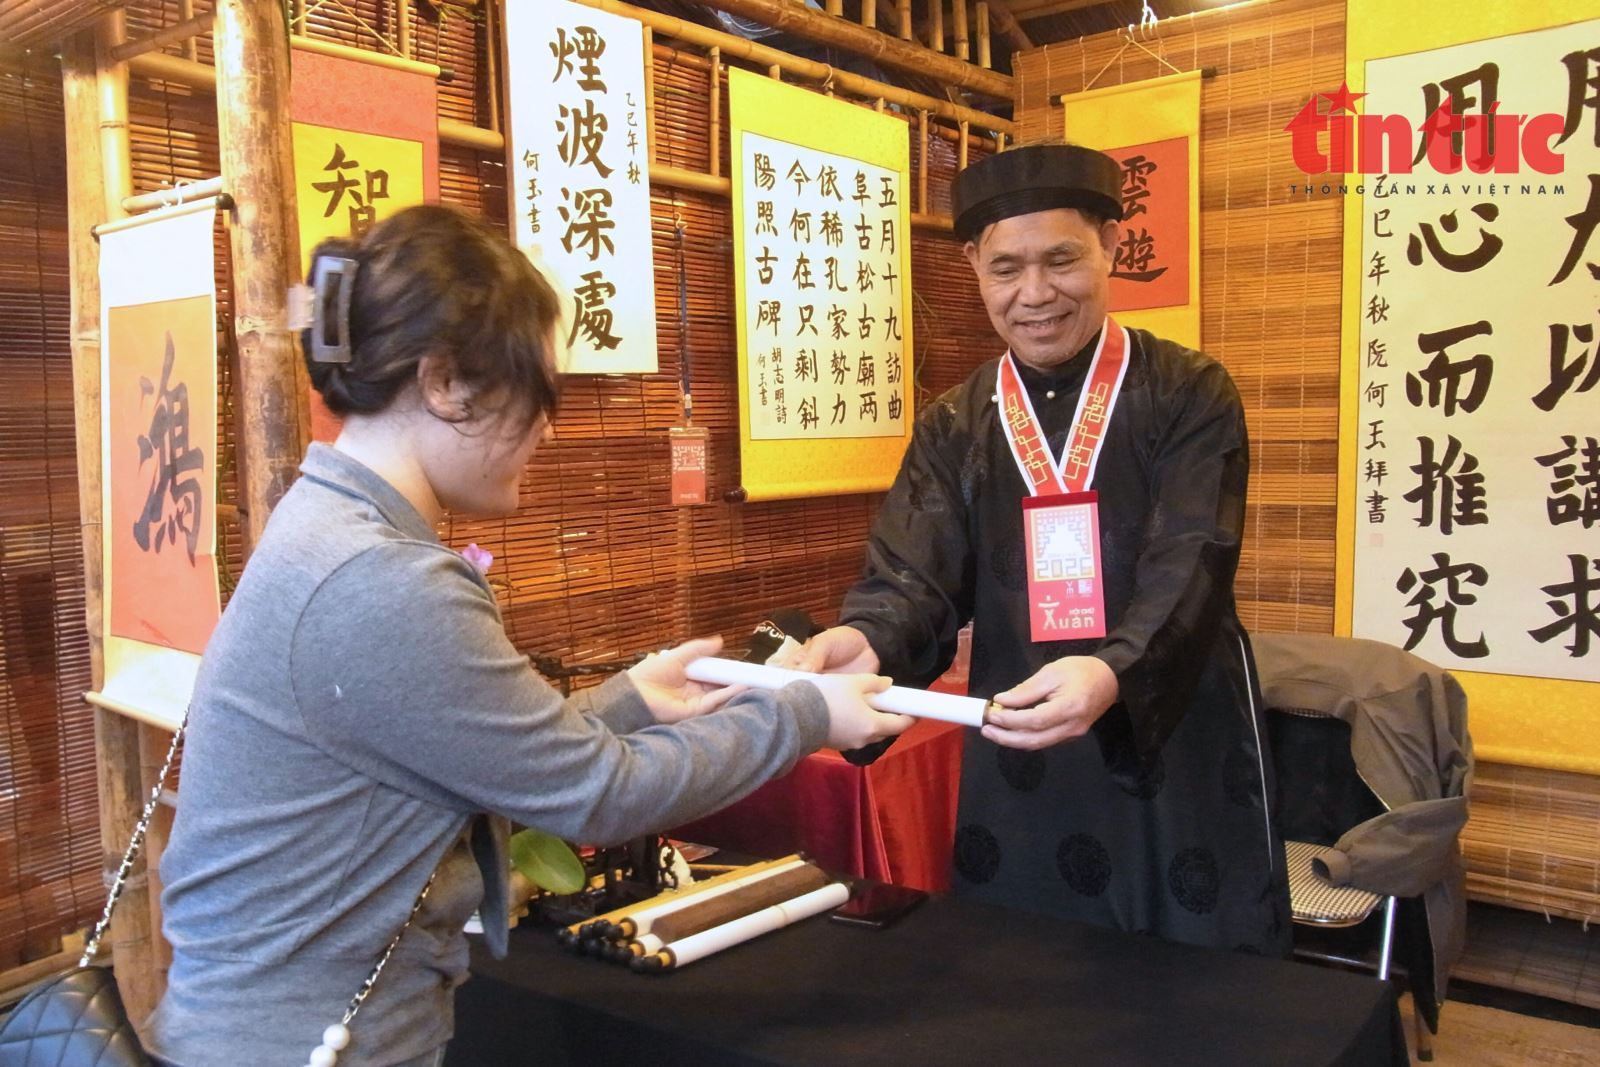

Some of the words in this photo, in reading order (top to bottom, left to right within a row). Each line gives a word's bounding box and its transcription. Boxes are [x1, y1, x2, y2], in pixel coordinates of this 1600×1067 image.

[311, 143, 390, 236] 智
[753, 152, 782, 337] 陽照古碑
[786, 158, 820, 431] 今何在只剩斜
[816, 164, 851, 425] 依稀孔家勢力
[1108, 155, 1168, 282] 雲遊
[771, 347, 787, 424] 胡志明詩
[878, 177, 902, 421] 五月十九訪曲
[1396, 62, 1503, 659] 用心而推究
